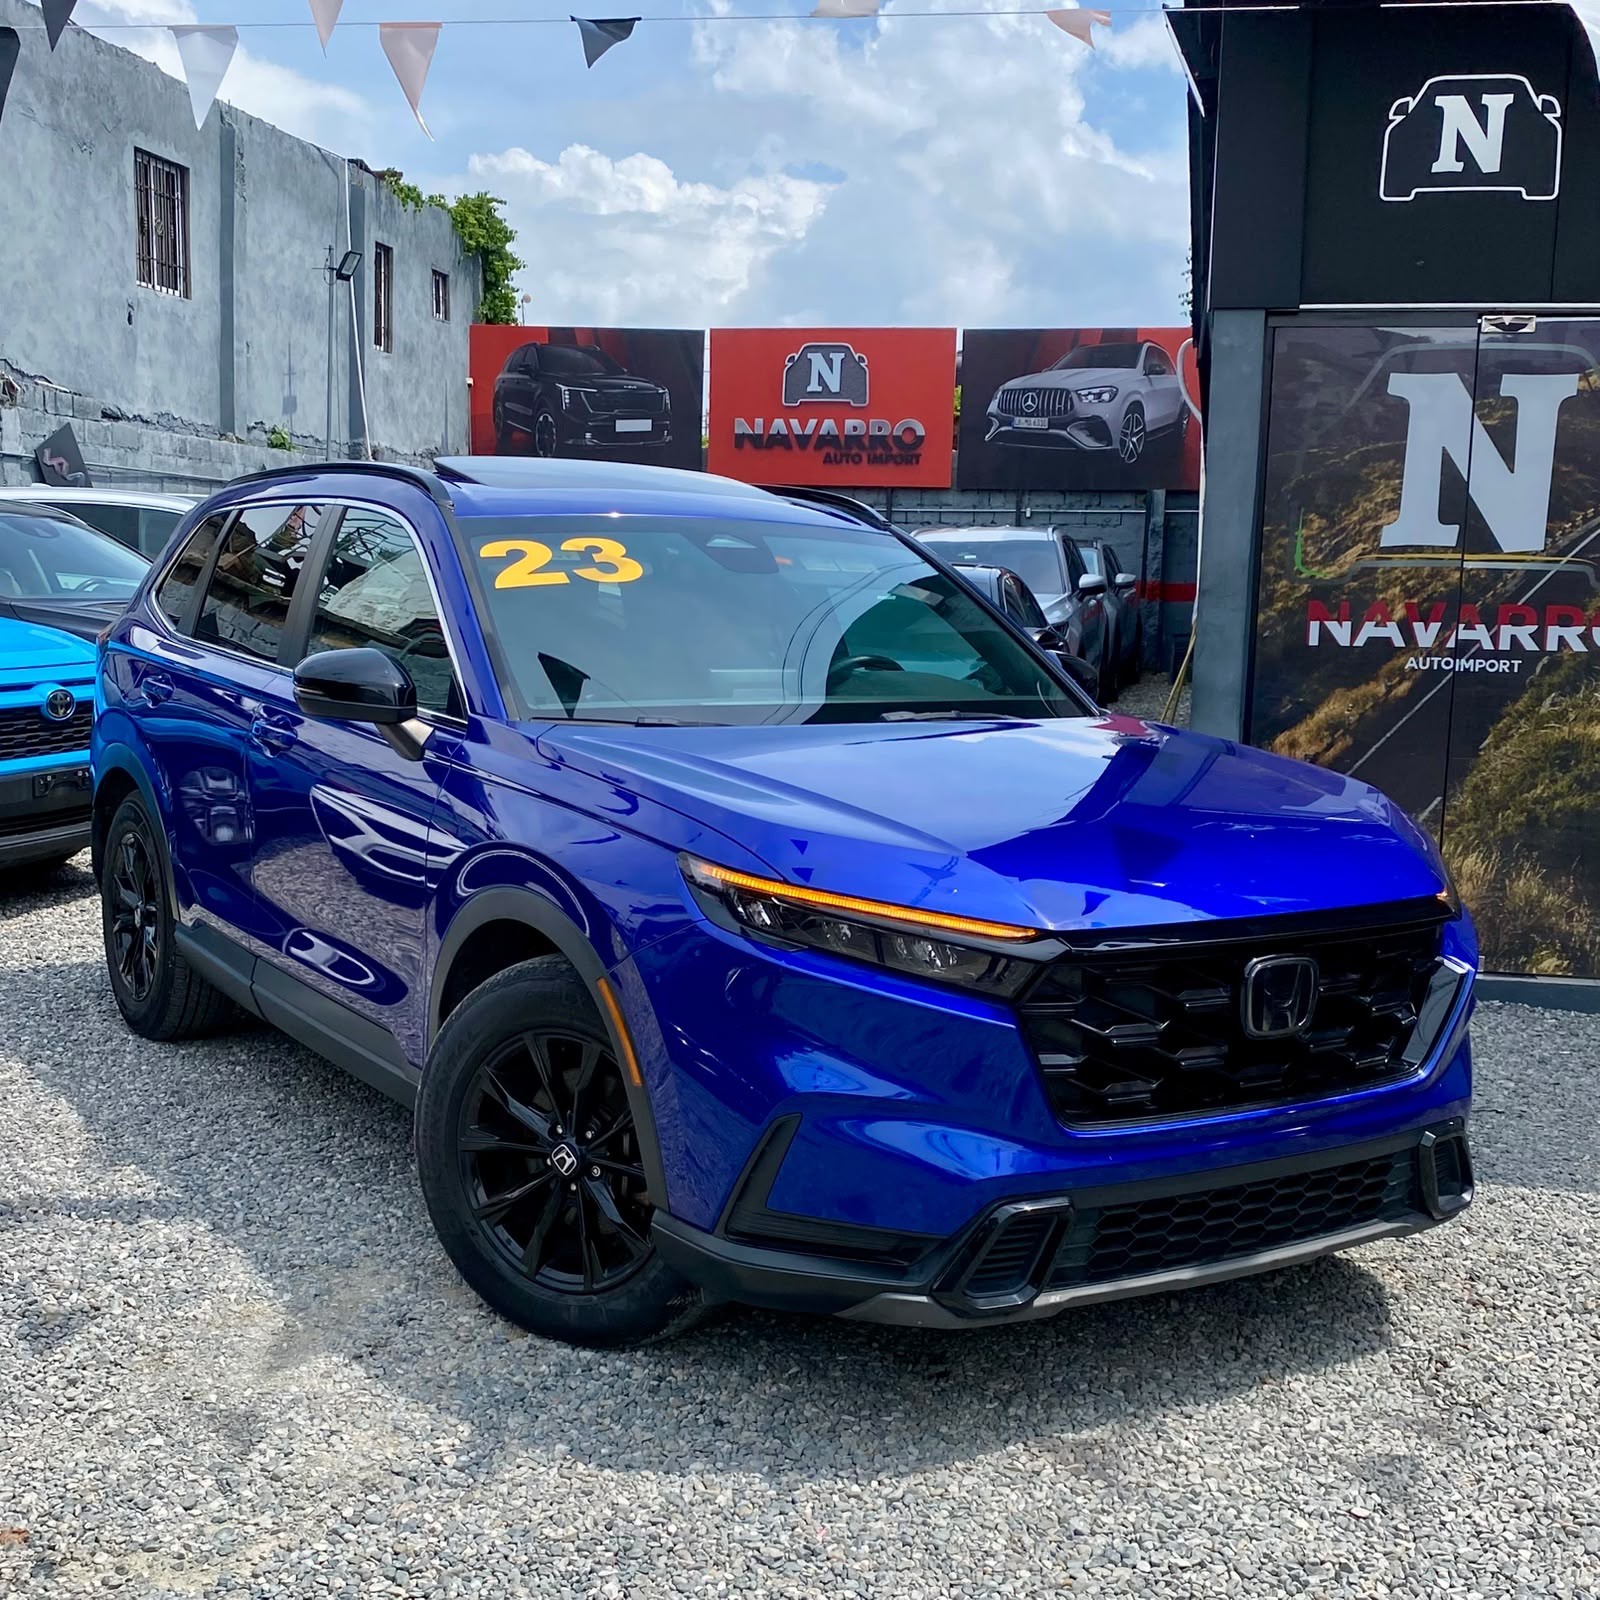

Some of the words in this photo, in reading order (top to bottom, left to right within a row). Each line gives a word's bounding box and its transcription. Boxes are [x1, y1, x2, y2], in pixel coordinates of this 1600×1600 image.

[1430, 93, 1515, 174] N
[806, 352, 846, 393] N
[734, 417, 926, 451] NAVARRO
[822, 453, 863, 465] AUTO
[867, 453, 922, 467] IMPORT
[1379, 372, 1580, 554] N
[480, 537, 644, 590] 23
[1306, 600, 1600, 652] NAVARR
